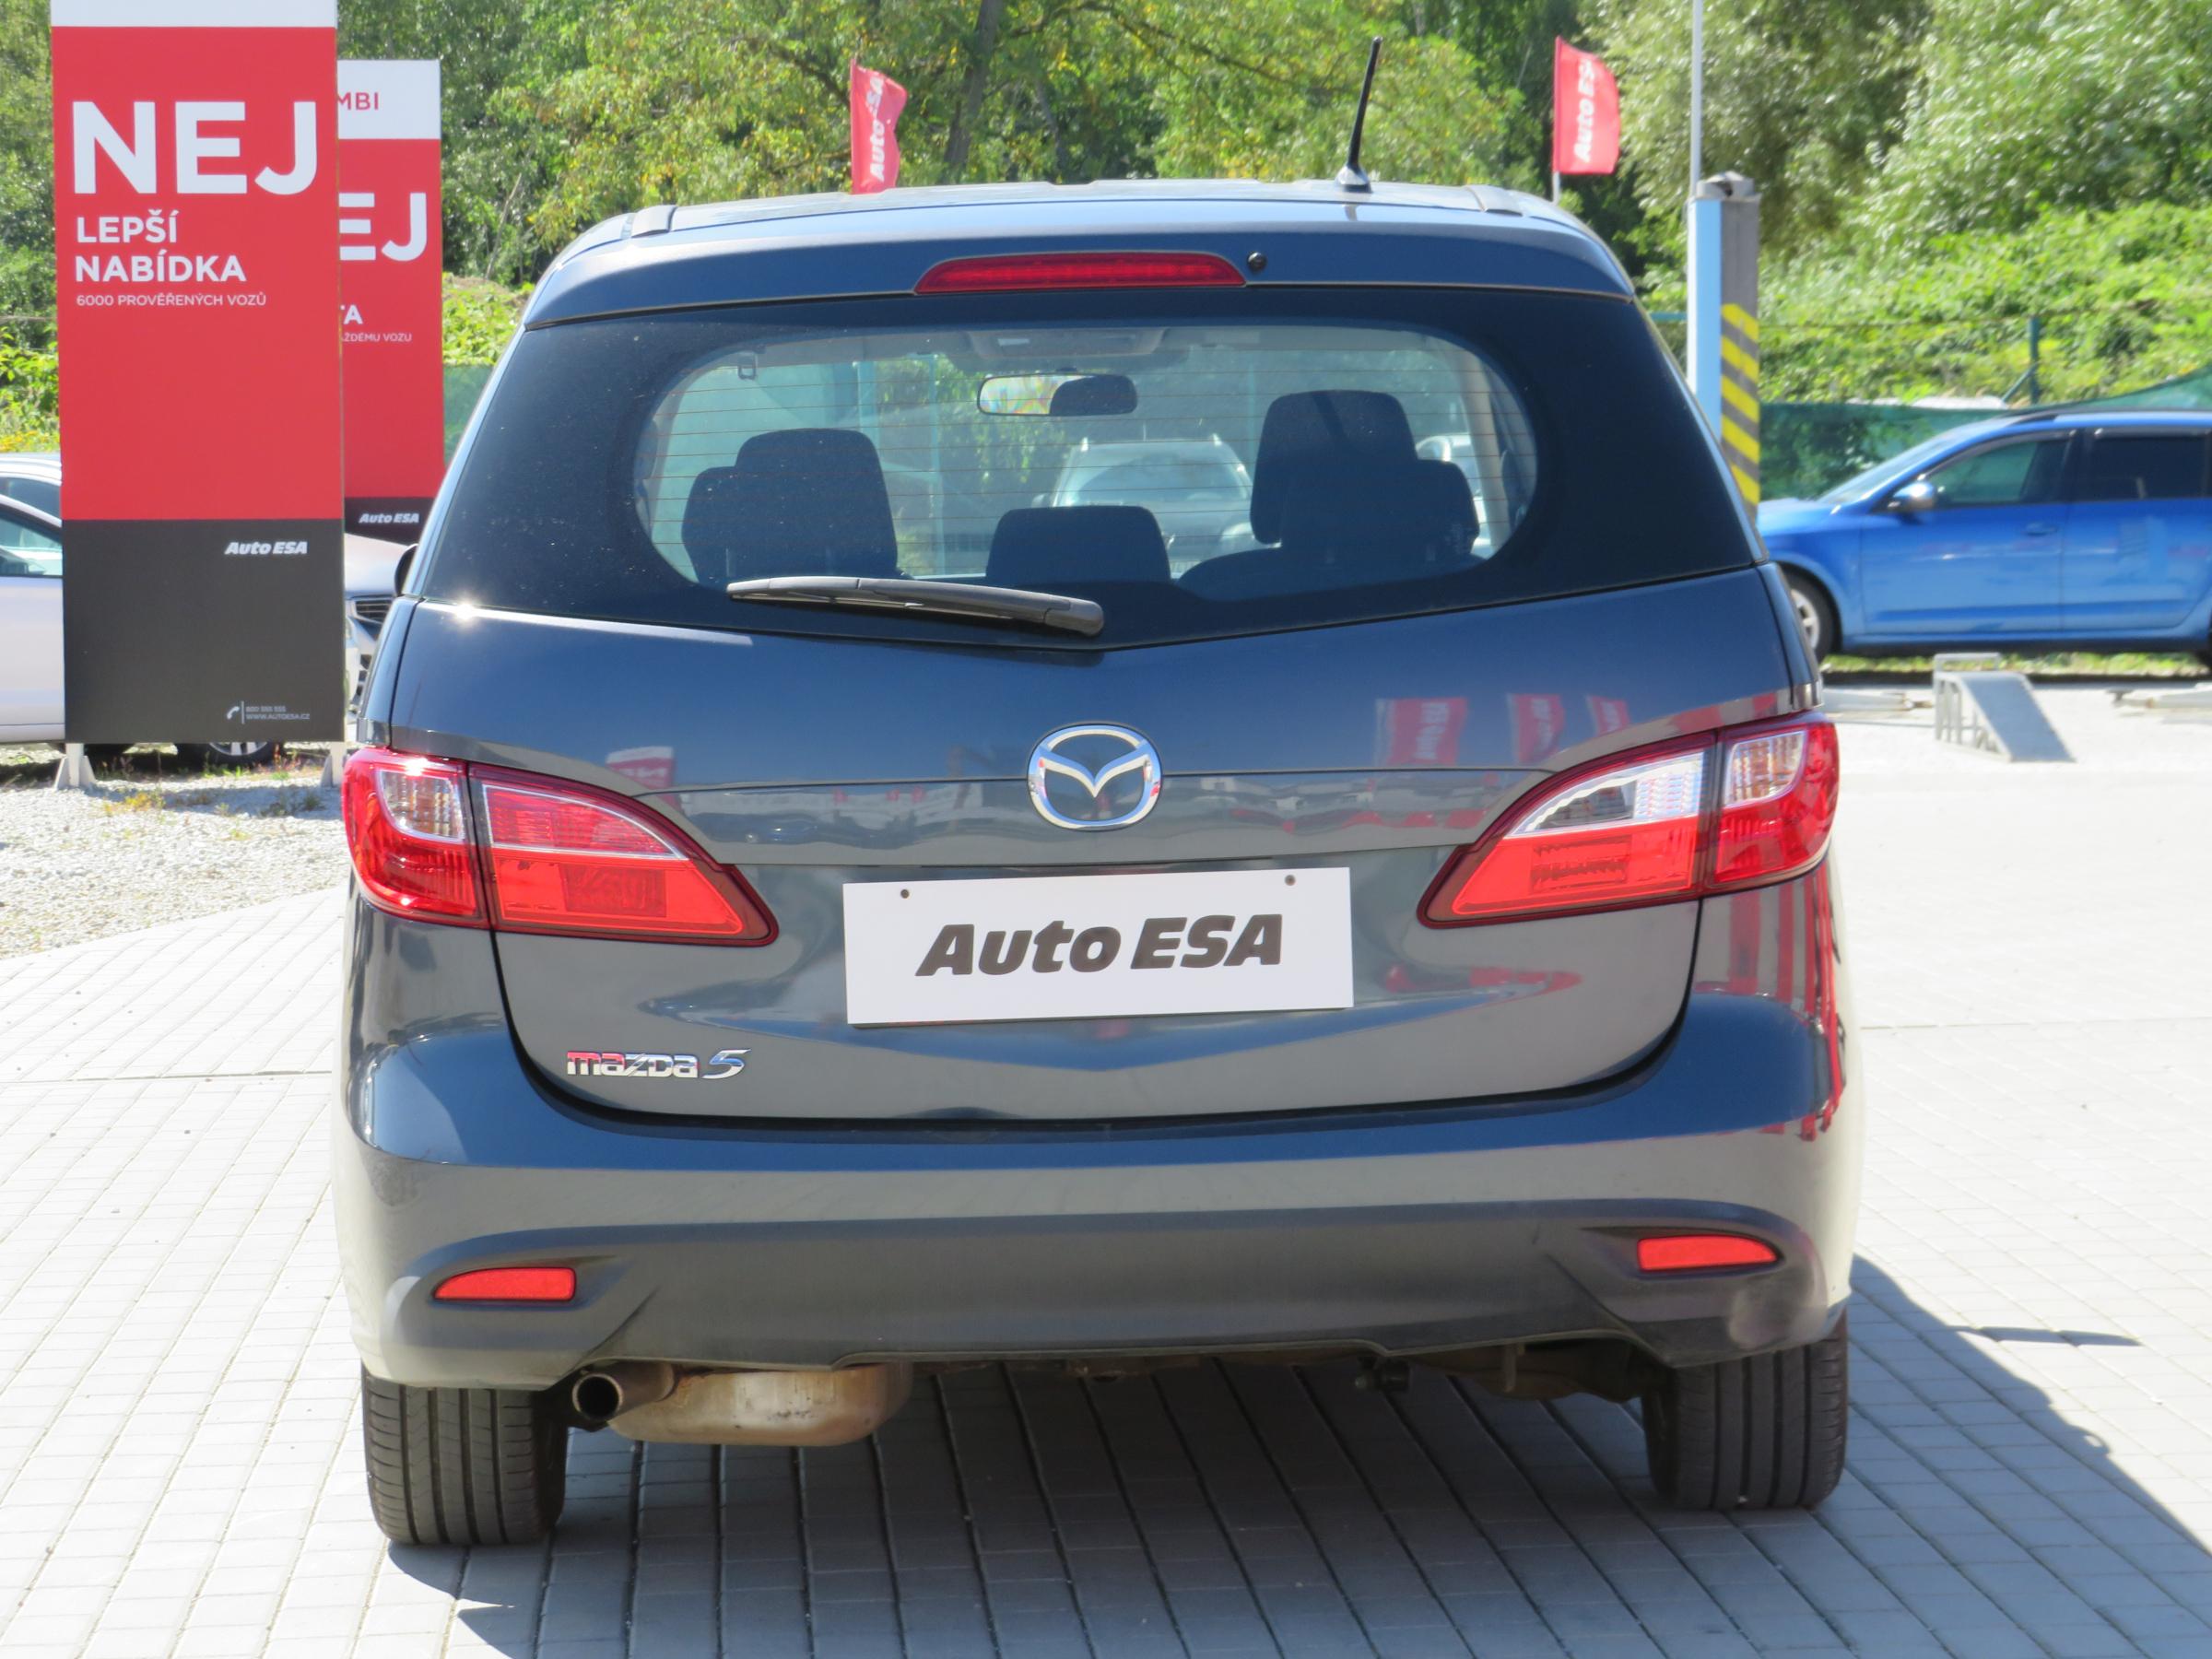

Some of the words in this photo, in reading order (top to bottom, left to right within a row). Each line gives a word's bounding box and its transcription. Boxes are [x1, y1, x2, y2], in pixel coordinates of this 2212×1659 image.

[72, 100, 318, 195] NEJ
[1573, 98, 1594, 163] Auto
[868, 118, 885, 182] Auto
[76, 208, 180, 243] LEPŠÍ
[75, 248, 247, 282] NABÍDKA
[76, 293, 115, 306] 6000
[117, 291, 223, 307] PROVĚŘENÝCH
[226, 290, 267, 306] VOZŮ
[342, 331, 381, 342] ŽDÉMU
[382, 332, 412, 342] VOZU
[359, 512, 393, 524] Auto
[393, 512, 420, 524] ESA
[224, 540, 271, 555] Auto
[272, 540, 309, 555] ESA
[914, 920, 1123, 977] Auto
[1130, 913, 1284, 971] ESA
[566, 1050, 699, 1078] mazda
